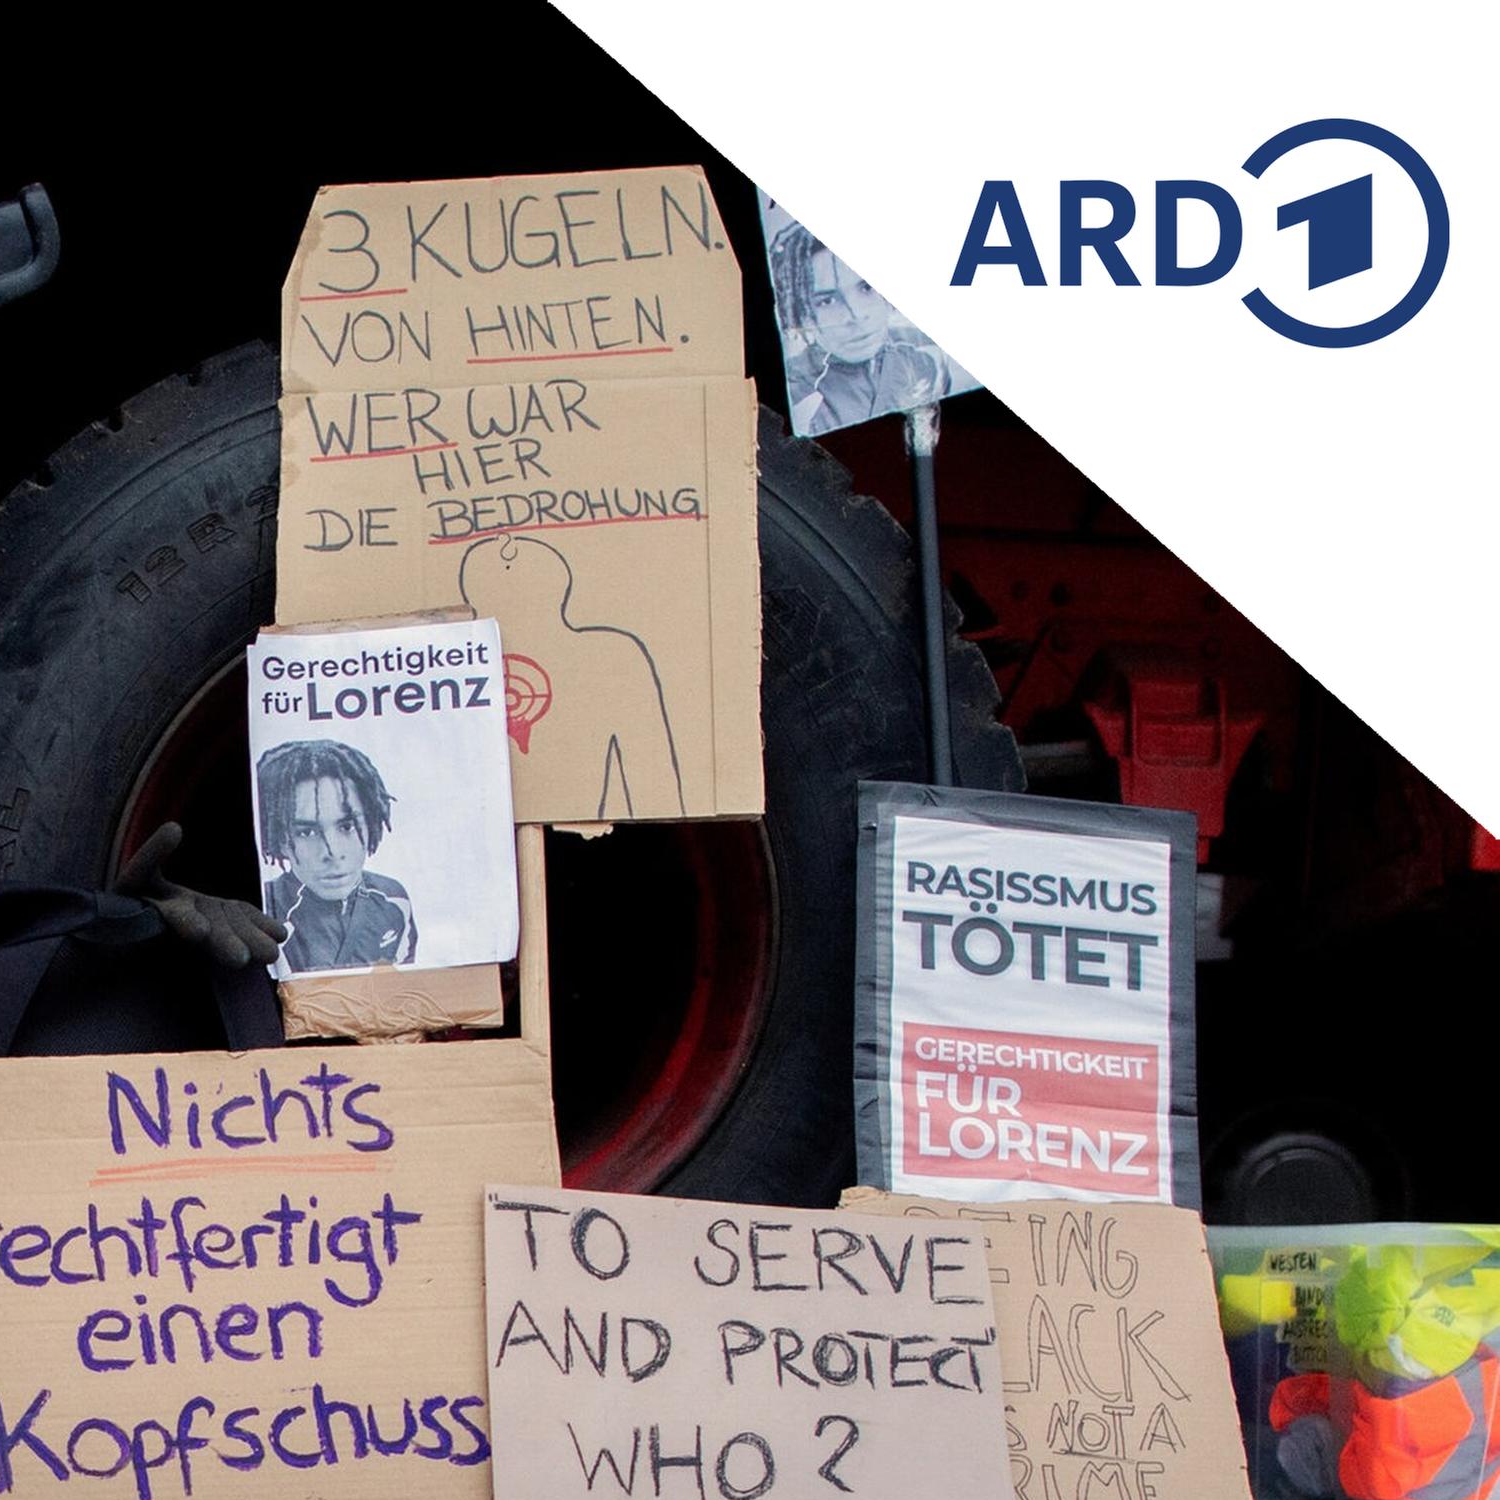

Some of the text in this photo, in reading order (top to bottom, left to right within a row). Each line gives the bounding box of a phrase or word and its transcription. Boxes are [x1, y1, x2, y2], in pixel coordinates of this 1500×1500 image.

[318, 182, 726, 293] 3 KUGELN.
[301, 295, 690, 367] VON HINTEN.
[306, 379, 601, 457] WER WAR
[413, 438, 551, 493] HIER
[303, 487, 702, 552] DIE BEDROHUNG
[261, 641, 490, 682] Gerechtigkeit
[261, 674, 493, 722] für Lorenz
[906, 861, 1157, 916] RASISSMUS
[902, 900, 1159, 991] TÖTET
[914, 1036, 1149, 1080] GERECHTIGKEIT
[916, 1061, 1022, 1117] FÜR
[106, 1063, 394, 1156] Nichts
[918, 1111, 1151, 1176] LORENZ
[694, 1218, 985, 1306] SERVE
[904, 1206, 1138, 1299] ING
[78, 1294, 324, 1371] einen
[495, 1300, 671, 1383] AND
[1002, 1294, 1192, 1403] ACK
[1046, 1400, 1135, 1459] NOT
[1139, 1402, 1186, 1453] A
